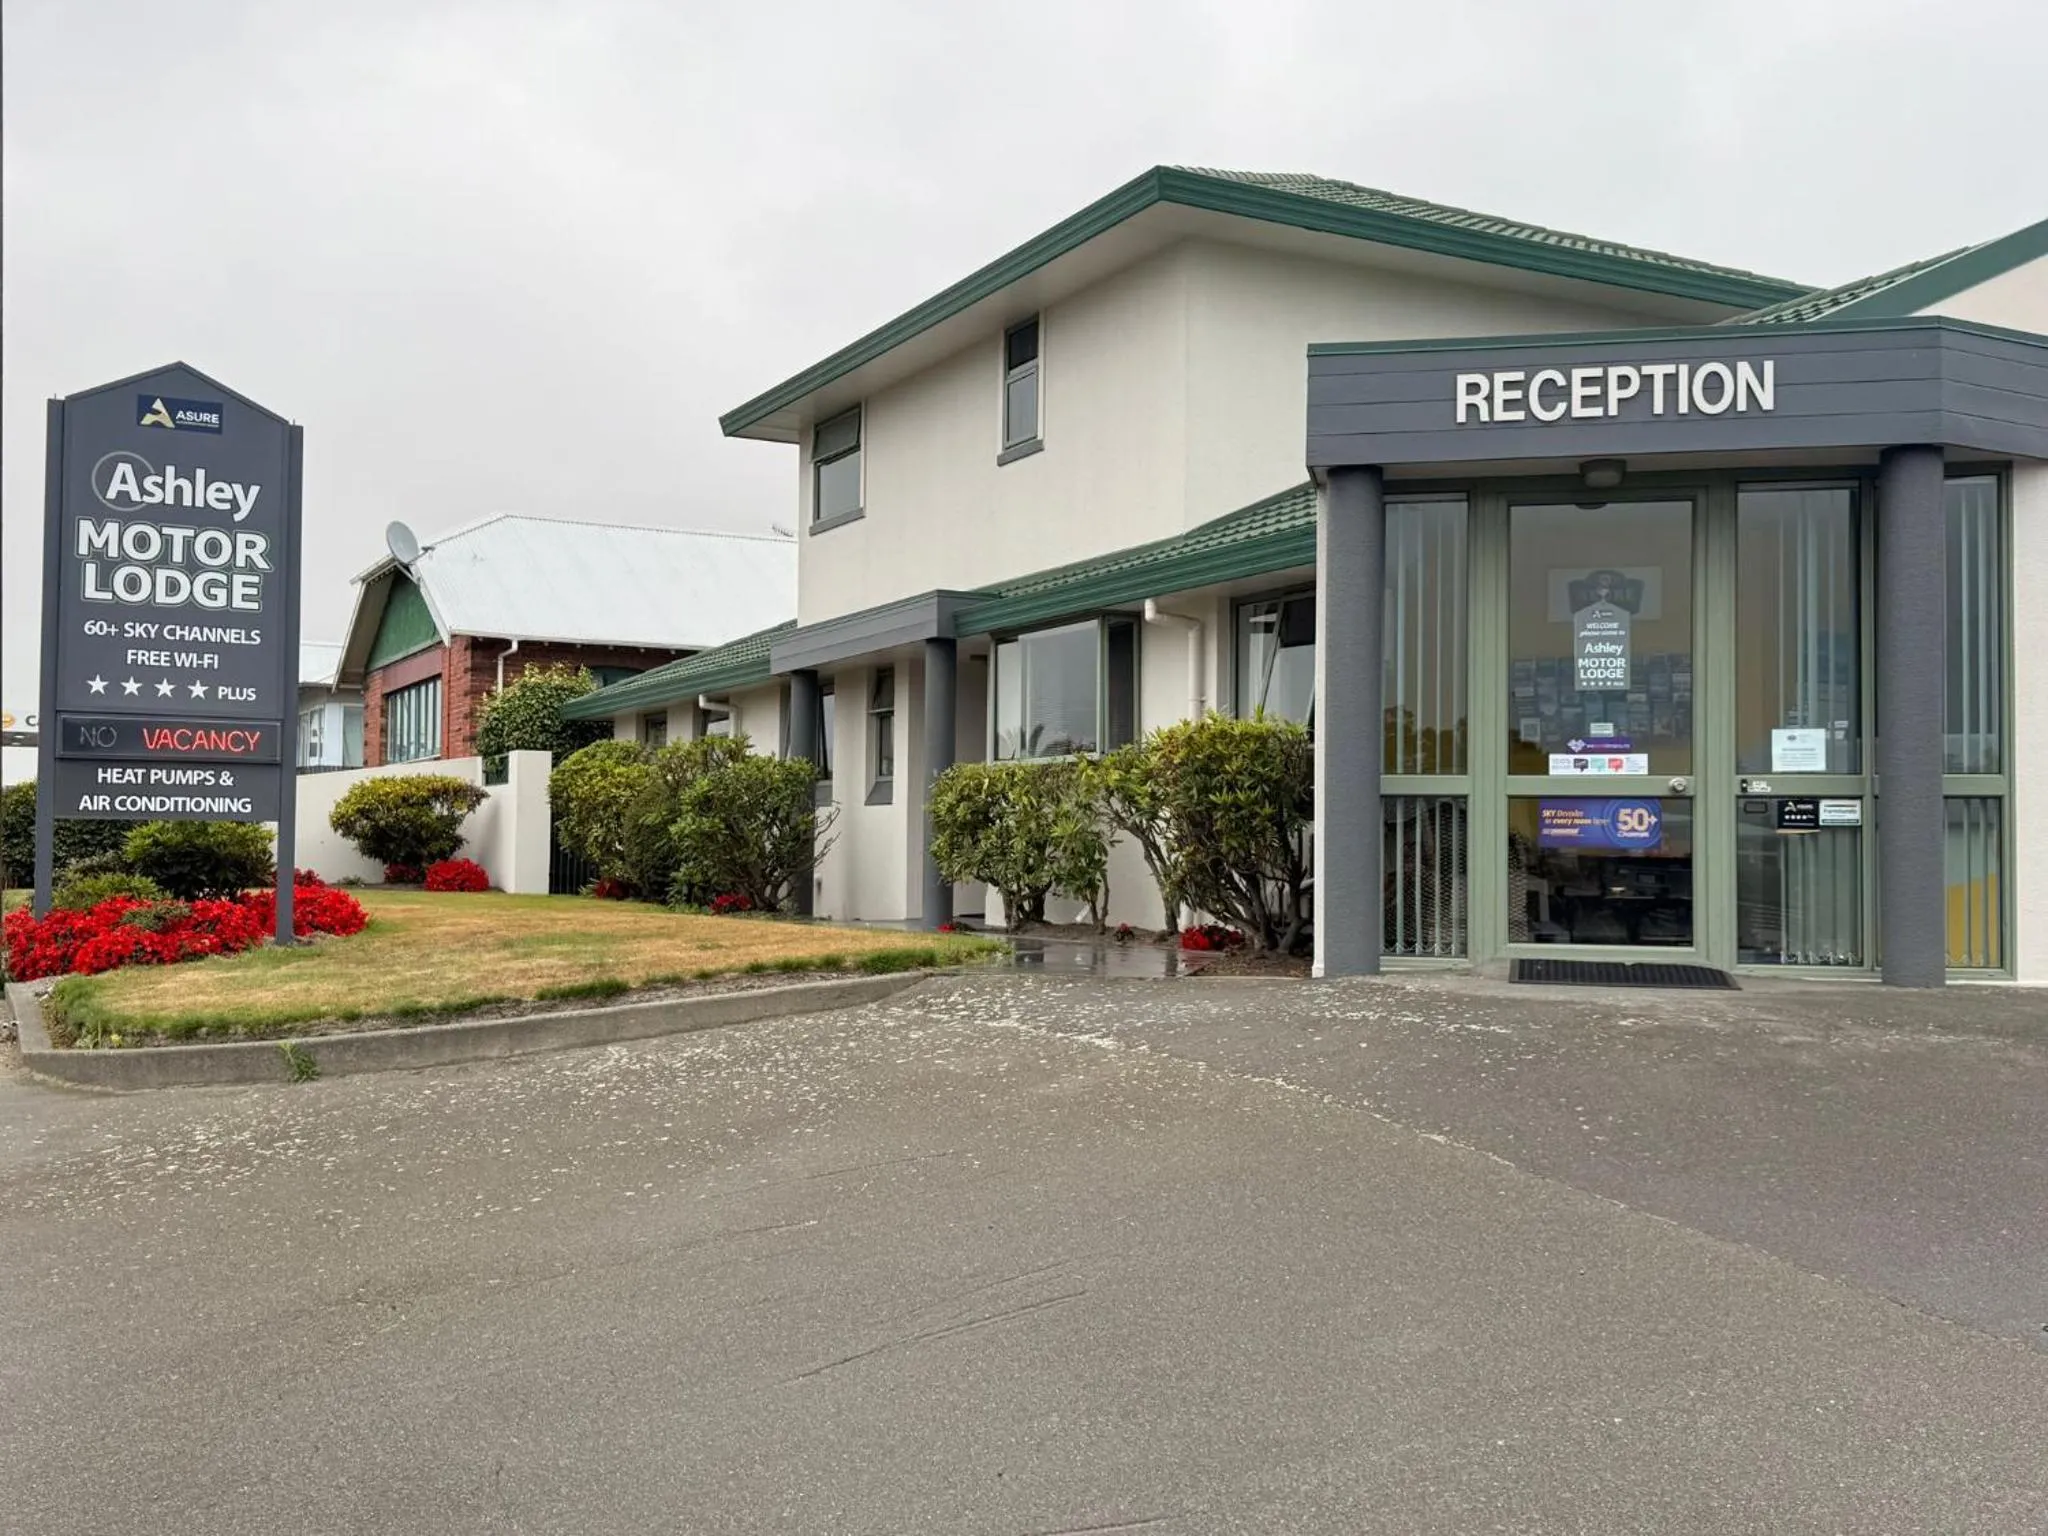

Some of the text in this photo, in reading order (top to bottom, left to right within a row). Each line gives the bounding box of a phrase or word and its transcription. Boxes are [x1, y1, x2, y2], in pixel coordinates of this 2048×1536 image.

[1455, 360, 1775, 424] RECEPTION
[175, 410, 220, 425] ASURE
[105, 462, 261, 522] Ashley
[77, 518, 272, 570] MOTOR
[83, 562, 262, 611] LODGE
[84, 620, 261, 645] 60+ SKY CHANNELS
[1584, 642, 1624, 656] Ashley
[127, 649, 219, 670] FREE WI-FI
[1578, 657, 1626, 668] MOTOR
[1580, 668, 1625, 679] LODGE
[217, 686, 257, 701] PLUS
[79, 726, 261, 752] NO VACANCY
[97, 767, 234, 787] HEAT PUMPS &
[79, 795, 252, 813] AIR CONDITIONING
[1542, 809, 1556, 818] SKY
